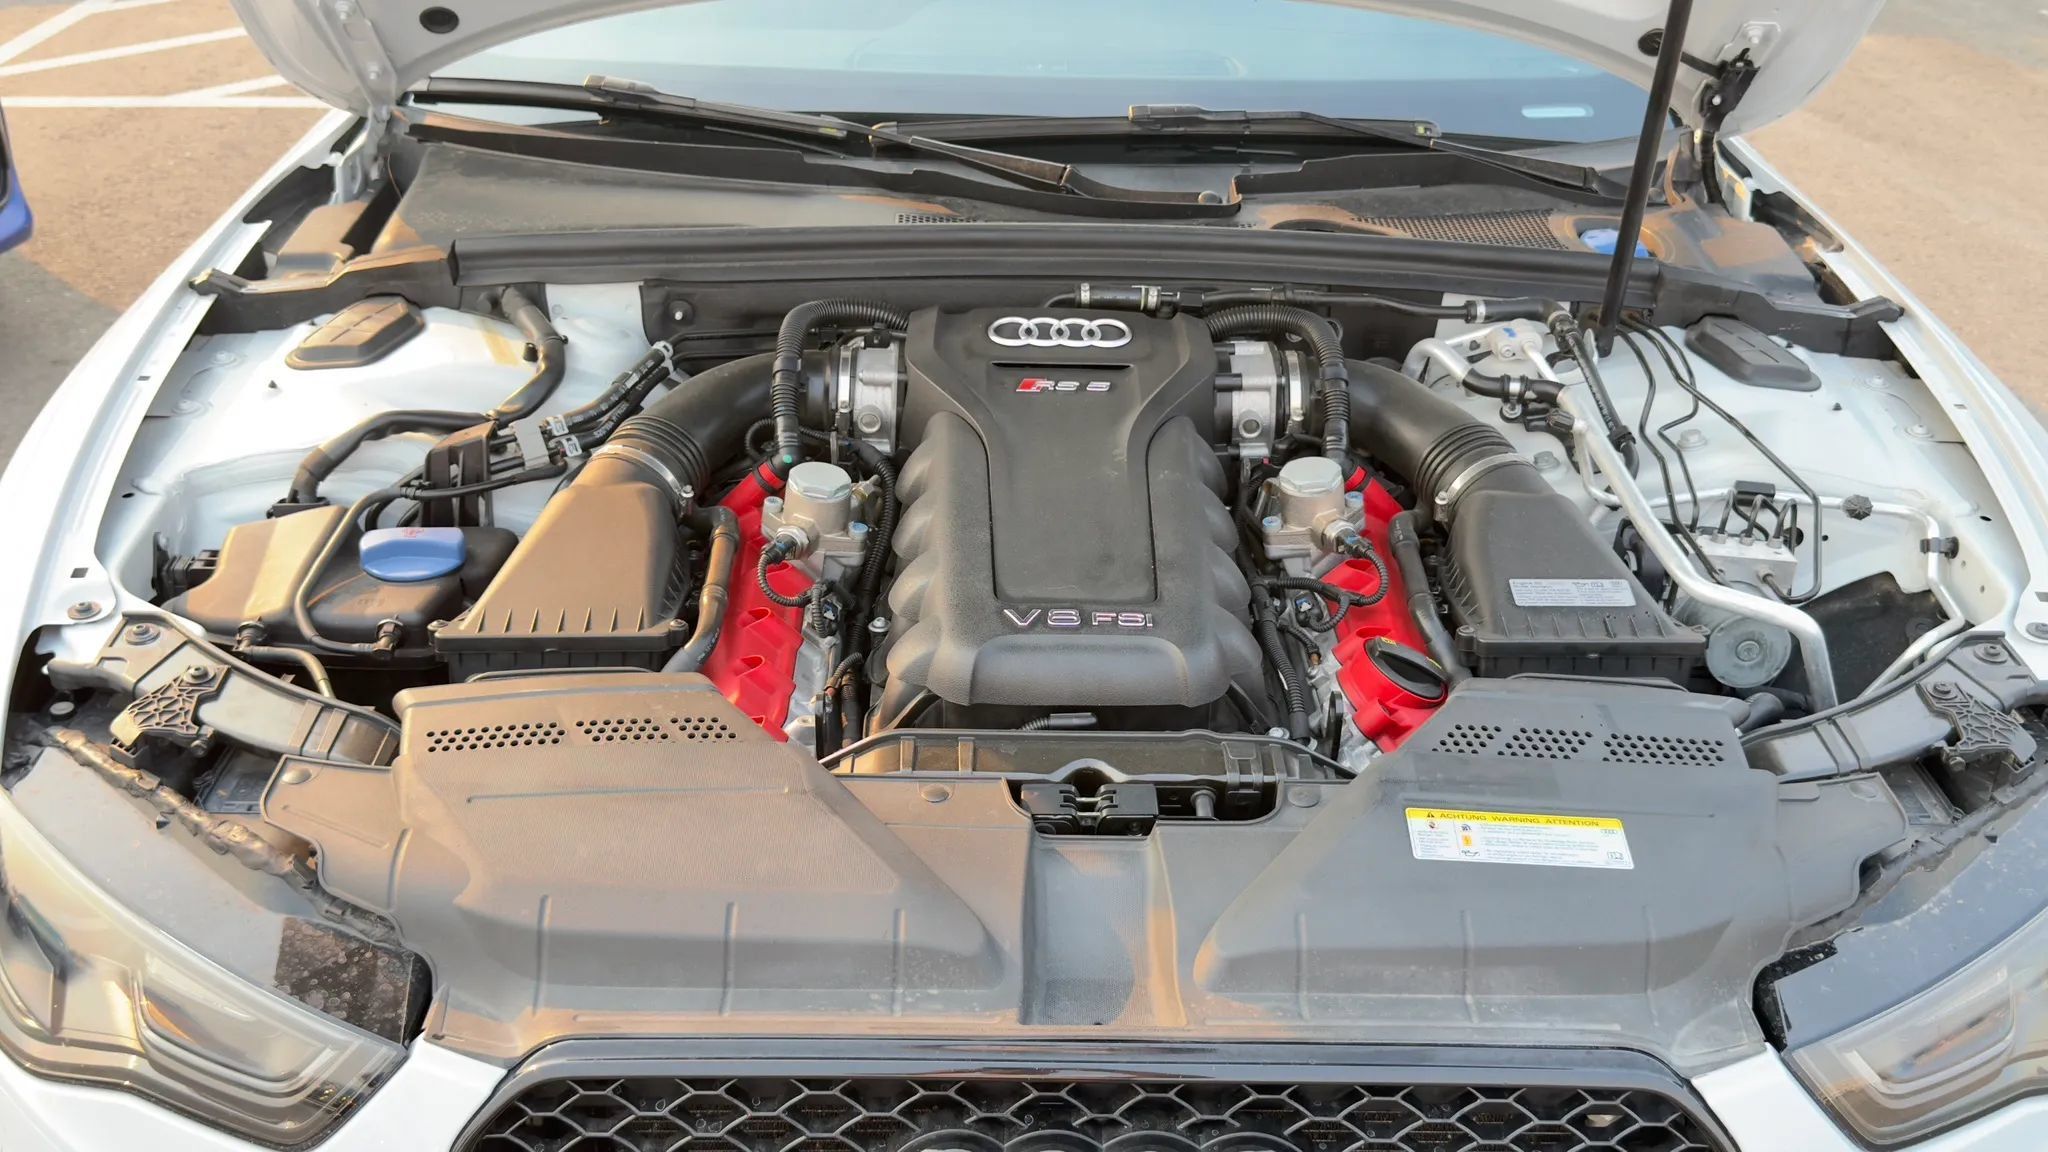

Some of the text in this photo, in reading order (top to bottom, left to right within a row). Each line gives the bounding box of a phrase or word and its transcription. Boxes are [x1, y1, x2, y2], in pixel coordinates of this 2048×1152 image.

[1016, 378, 1080, 392] RS
[1092, 611, 1153, 627] FSI
[1439, 812, 1600, 827] ACHTUNG WARNING ATTENTION
